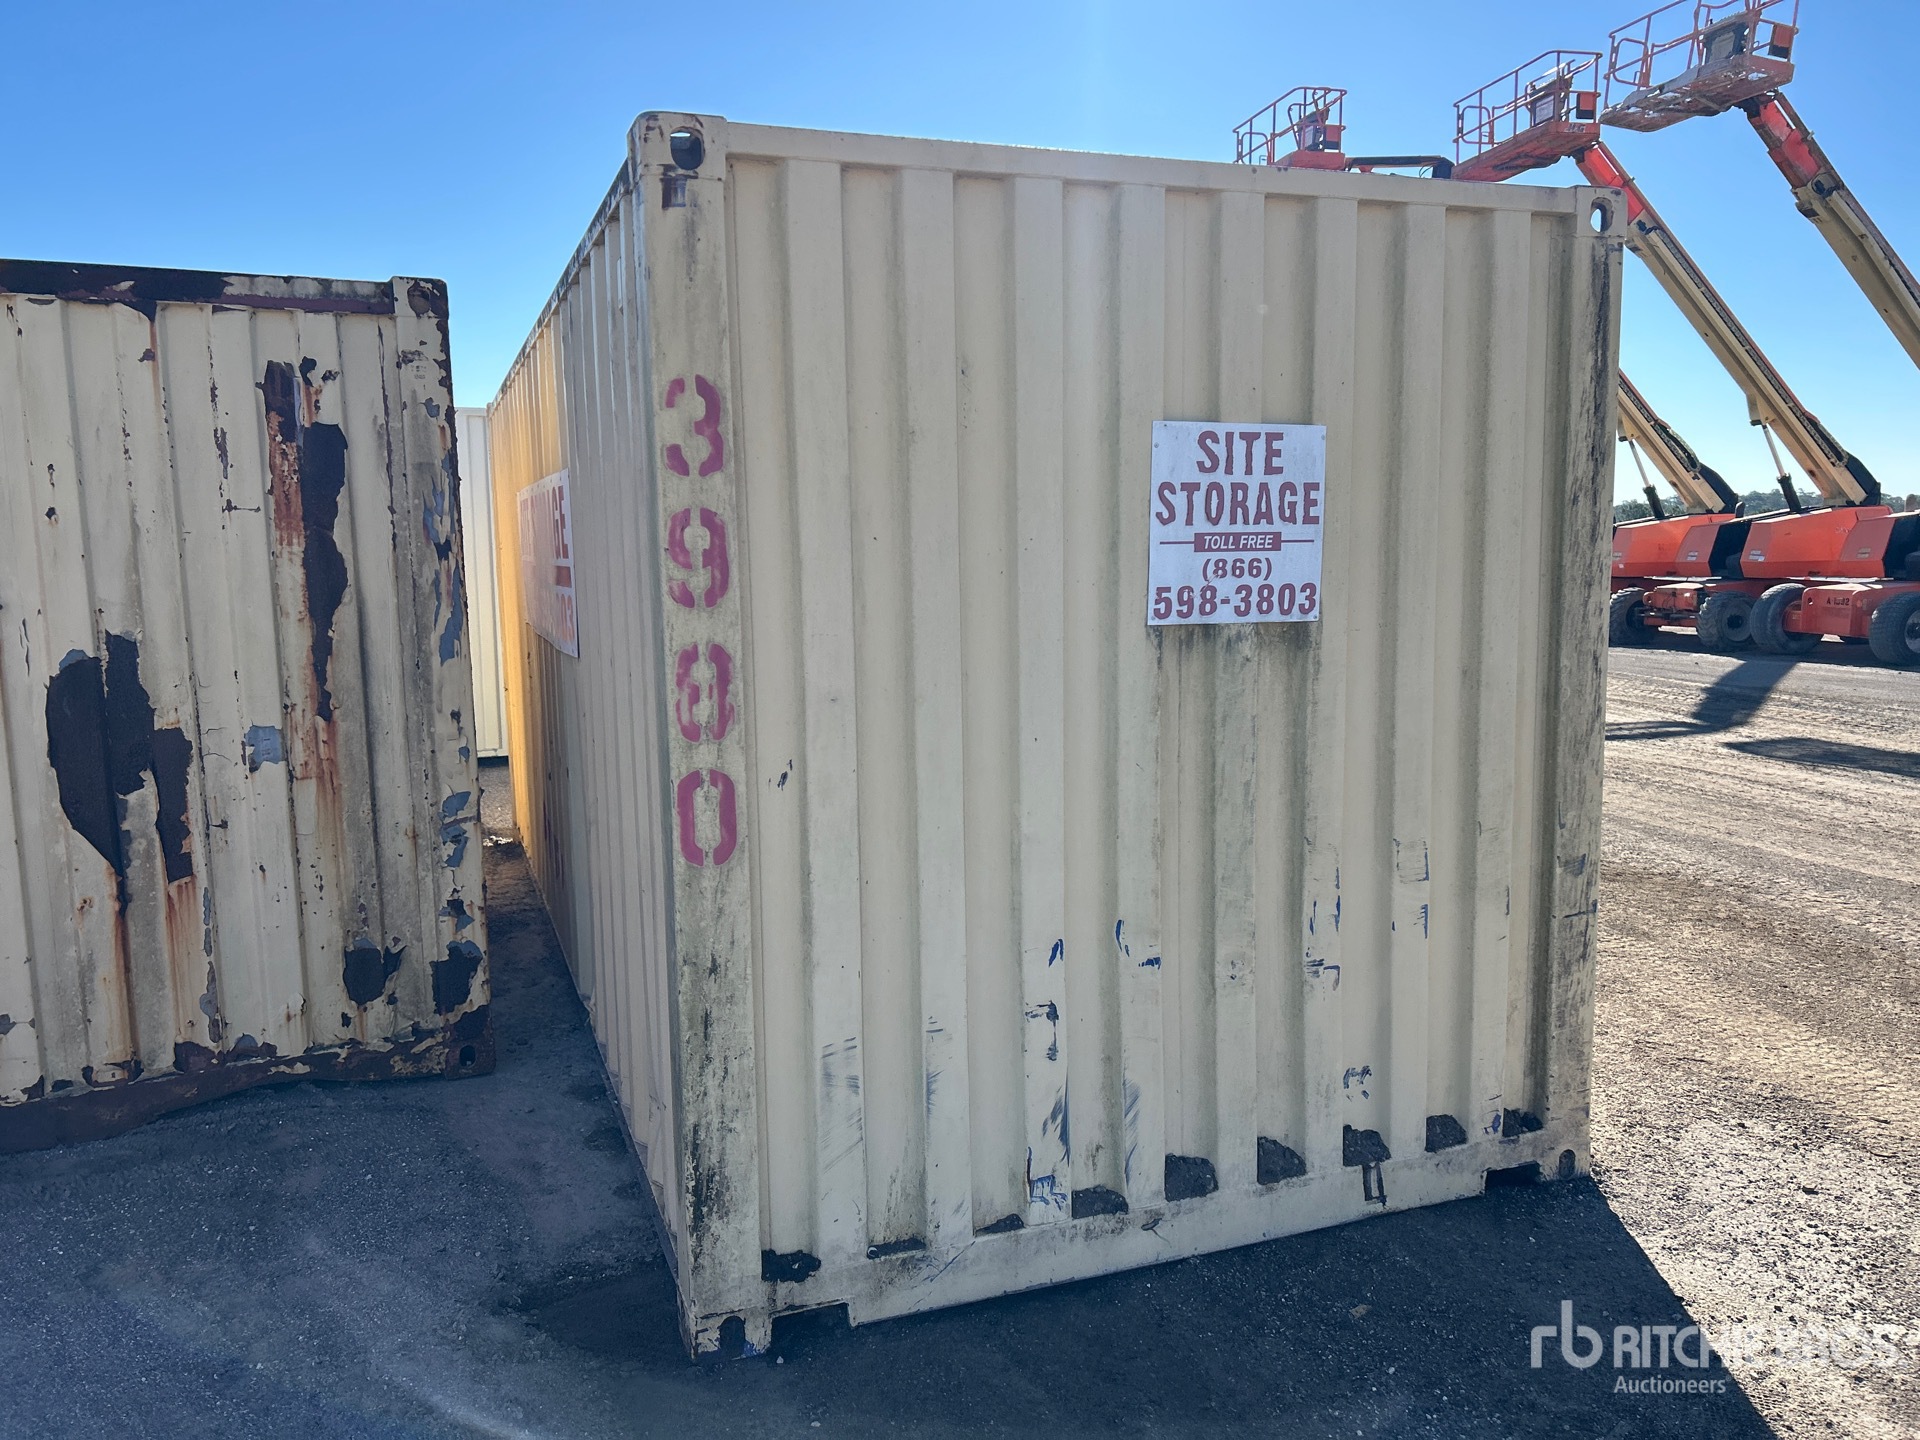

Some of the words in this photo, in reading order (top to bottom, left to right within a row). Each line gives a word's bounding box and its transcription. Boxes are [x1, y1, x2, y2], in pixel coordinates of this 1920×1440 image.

[1196, 430, 1284, 475] SITE
[1155, 481, 1320, 526] STORAGE
[1203, 535, 1236, 549] TOLL
[1239, 534, 1274, 549] FREE
[1202, 557, 1272, 581] (866)
[1153, 582, 1317, 619] 598-3803
